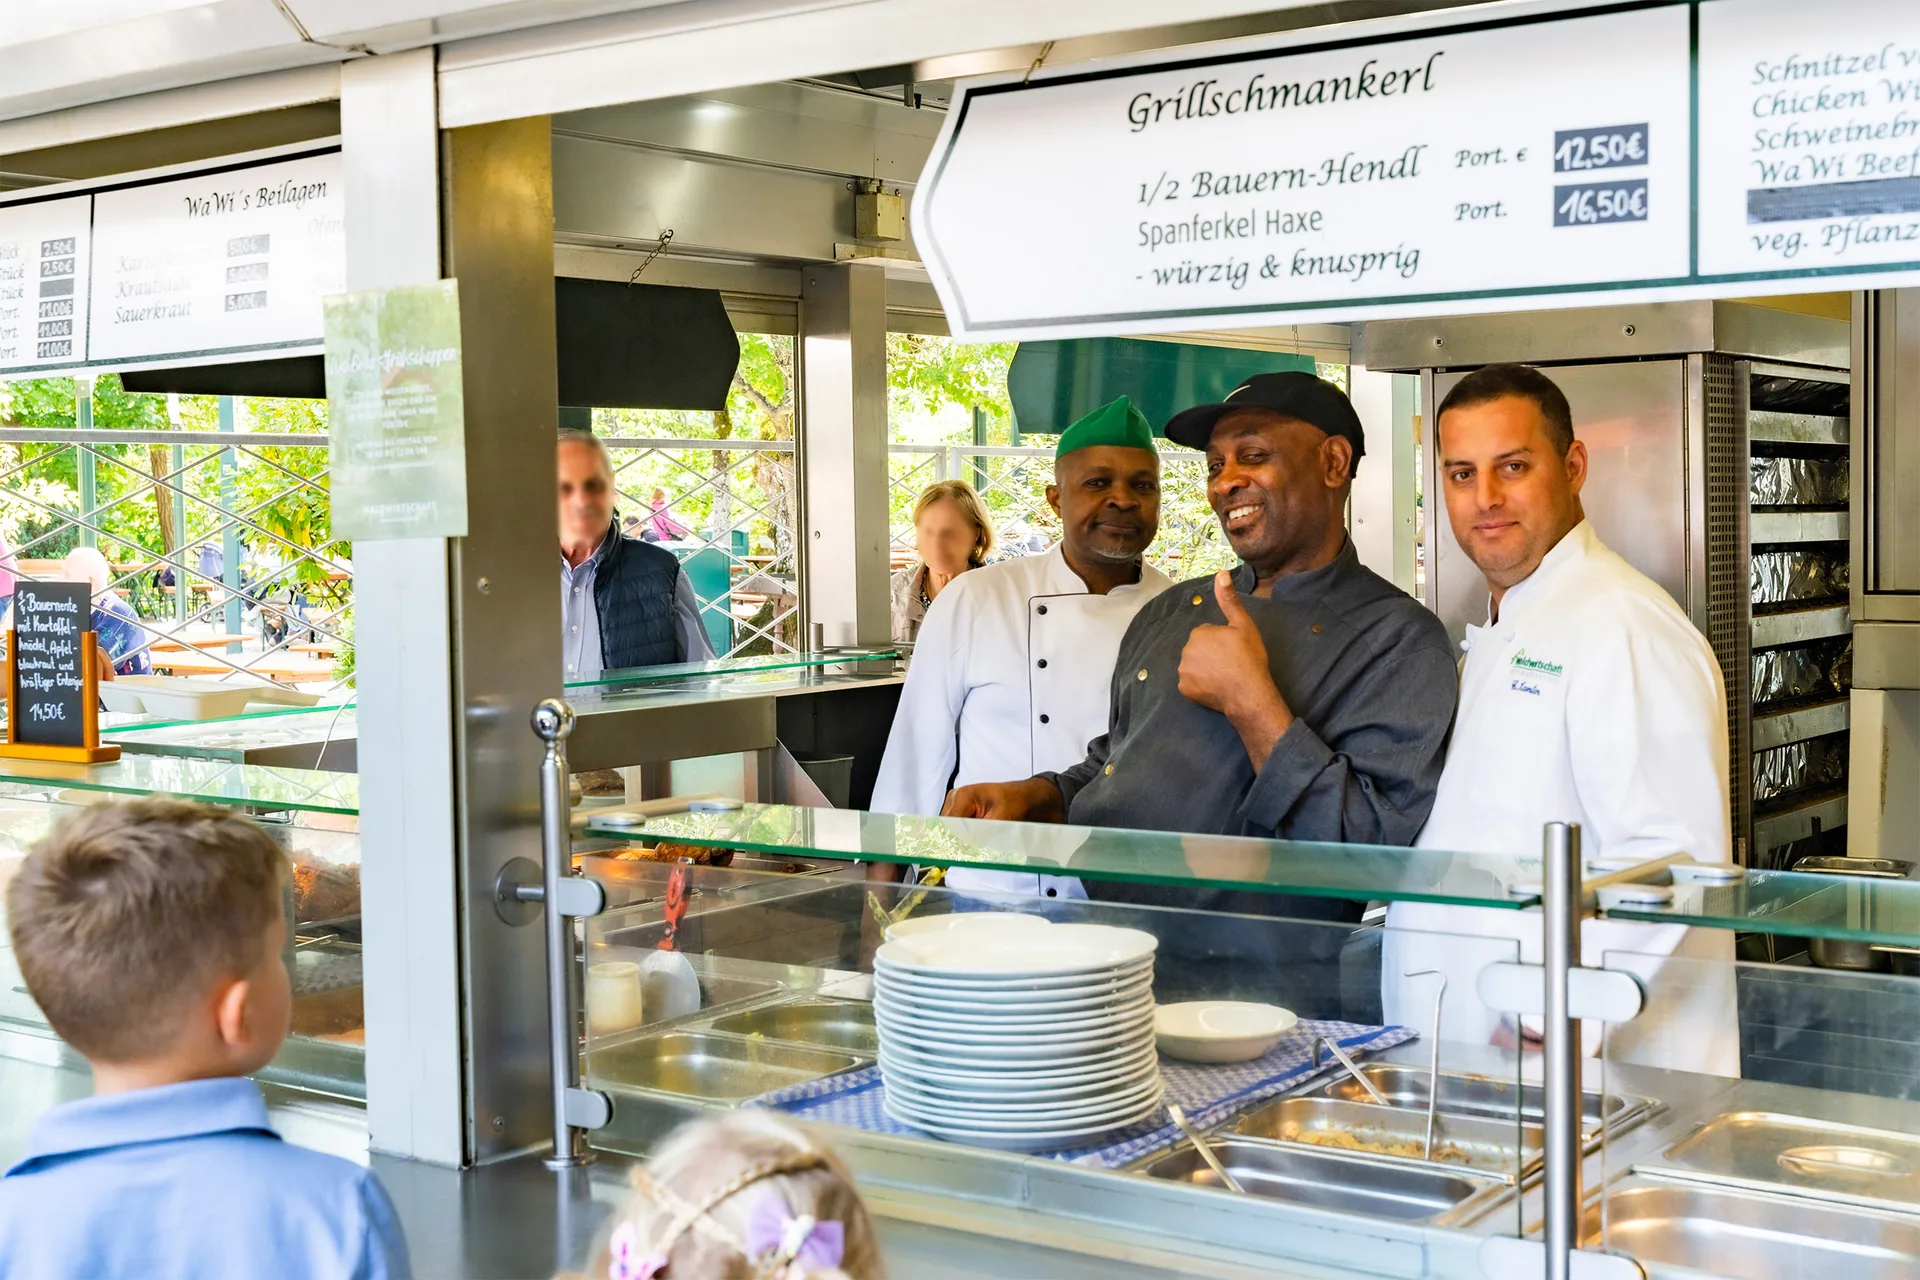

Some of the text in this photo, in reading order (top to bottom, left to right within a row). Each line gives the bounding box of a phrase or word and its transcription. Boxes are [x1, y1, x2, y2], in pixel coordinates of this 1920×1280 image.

[1752, 42, 1895, 85] Schnitzel
[1128, 52, 1445, 133] Grillschmankerl
[1752, 84, 1867, 118] Chicken
[1455, 147, 1528, 168] Port. €
[1555, 131, 1646, 171] 12,50€
[1137, 145, 1428, 207] 1/2 Bauern-Hendl
[1752, 154, 1845, 185] WaWi
[256, 179, 328, 210] Beilagen
[1559, 187, 1648, 223] 16,50€
[1455, 201, 1508, 221] Port.
[1139, 208, 1324, 252] Spanferkel Haxe
[1752, 231, 1809, 259] veg.
[1152, 259, 1250, 290] würzig
[1259, 254, 1280, 279] &
[1290, 242, 1421, 283] knusprig
[0, 283, 24, 300] tück
[114, 299, 192, 324] Sauerkraut
[0, 327, 19, 340] ort.
[0, 346, 18, 359] ort.
[26, 592, 78, 614] Bauernente
[17, 615, 78, 636] mit Kartoffel-
[49, 639, 78, 659] Apfel-
[58, 659, 75, 671] und
[20, 672, 55, 693] kräftiger
[29, 702, 66, 721] 14,50€
